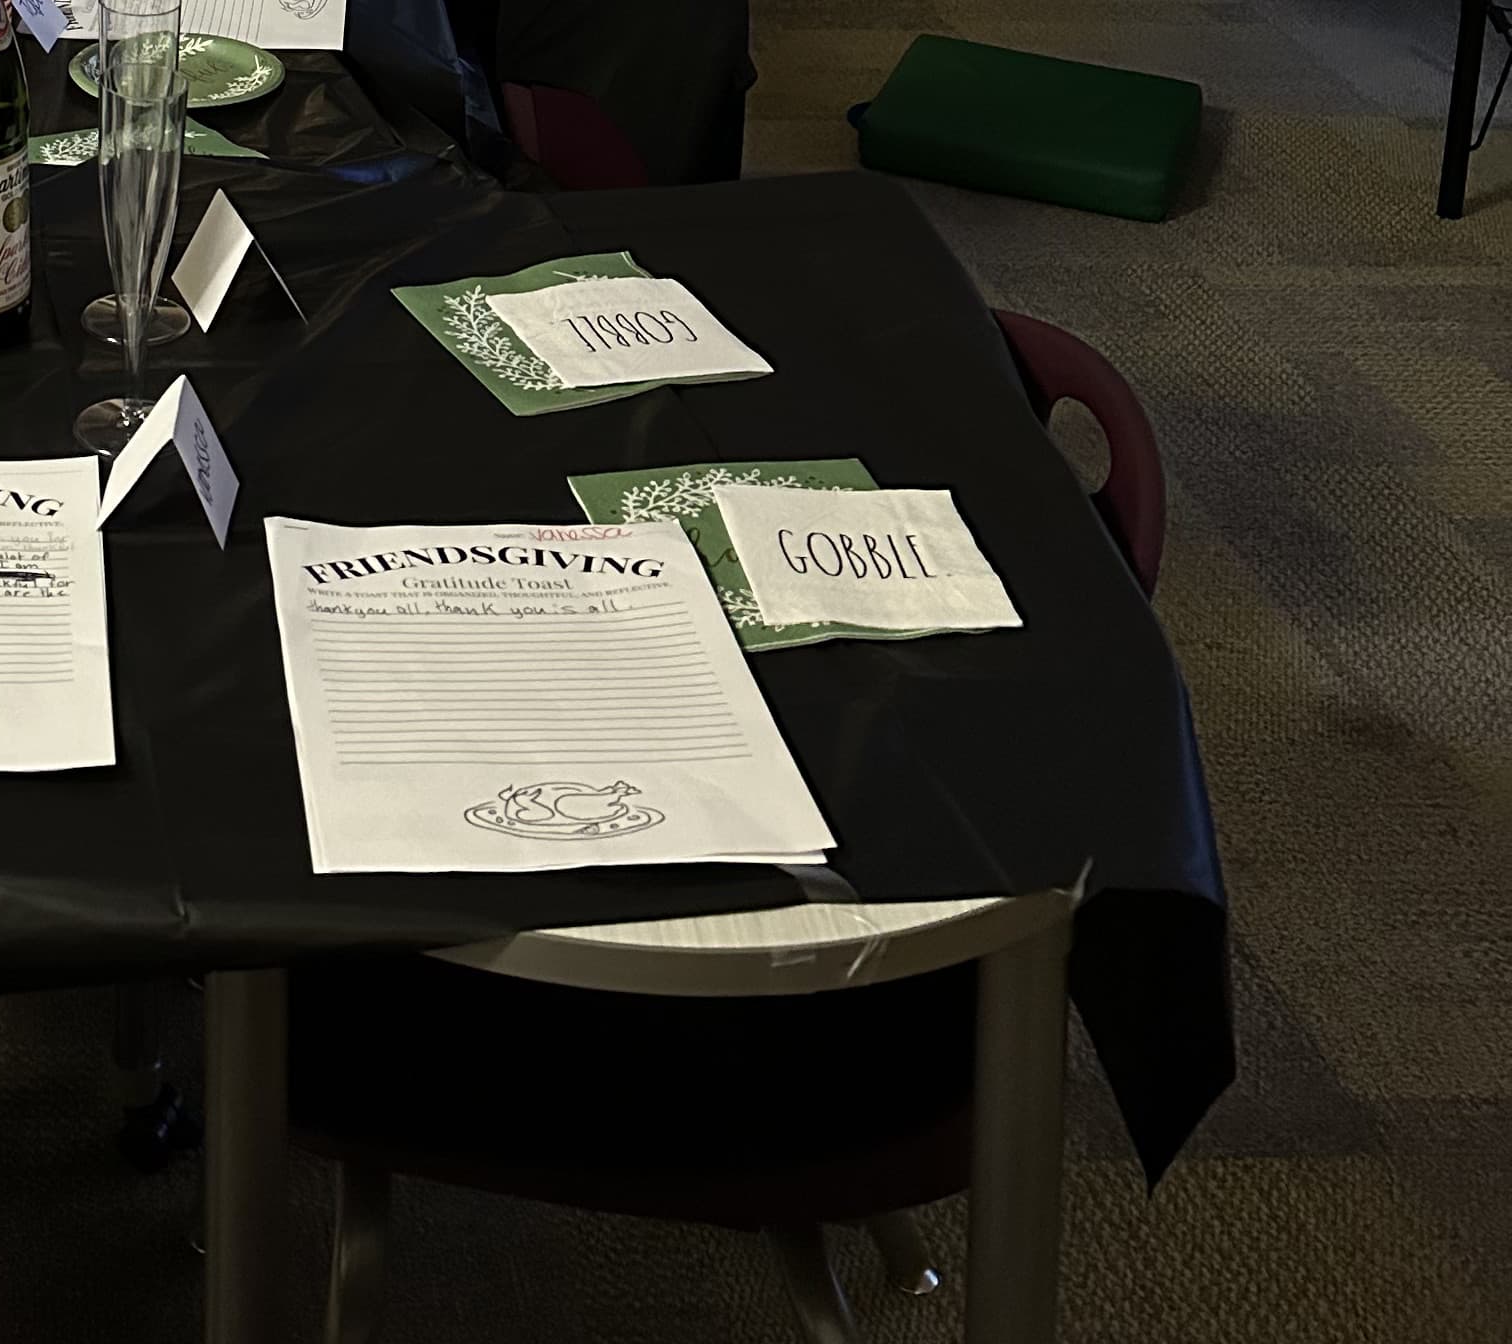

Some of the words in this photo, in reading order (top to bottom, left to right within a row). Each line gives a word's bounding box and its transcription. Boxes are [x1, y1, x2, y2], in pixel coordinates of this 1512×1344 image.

[562, 310, 698, 354] GOBBLE
[302, 545, 664, 585] FRIENDSGIVING
[778, 528, 936, 579] GOBBLE
[307, 587, 338, 597] WRITE
[402, 576, 506, 590] Gratitude
[512, 577, 573, 590] Toast
[435, 599, 494, 616] thank
[510, 605, 544, 619] you
